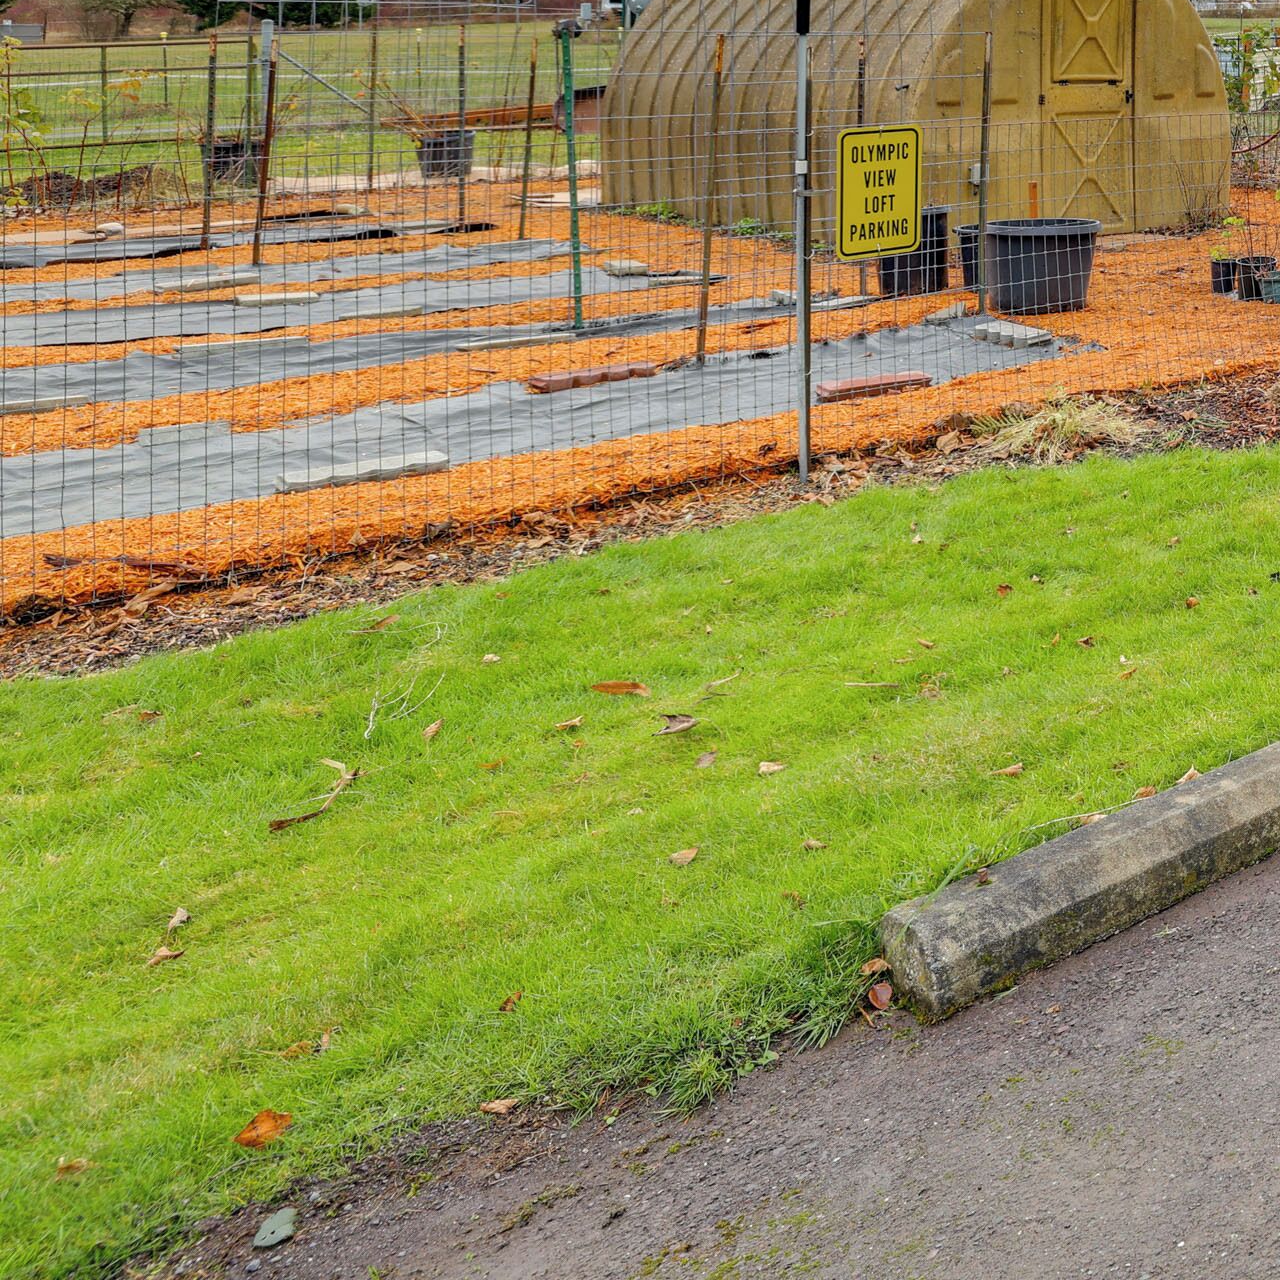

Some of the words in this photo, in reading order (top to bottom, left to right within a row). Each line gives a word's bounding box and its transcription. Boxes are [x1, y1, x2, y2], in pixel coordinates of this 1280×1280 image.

[851, 142, 909, 164] OLYMPIC
[864, 168, 897, 188] VIEW
[865, 194, 896, 214] LOFT
[850, 218, 908, 242] PARKING
